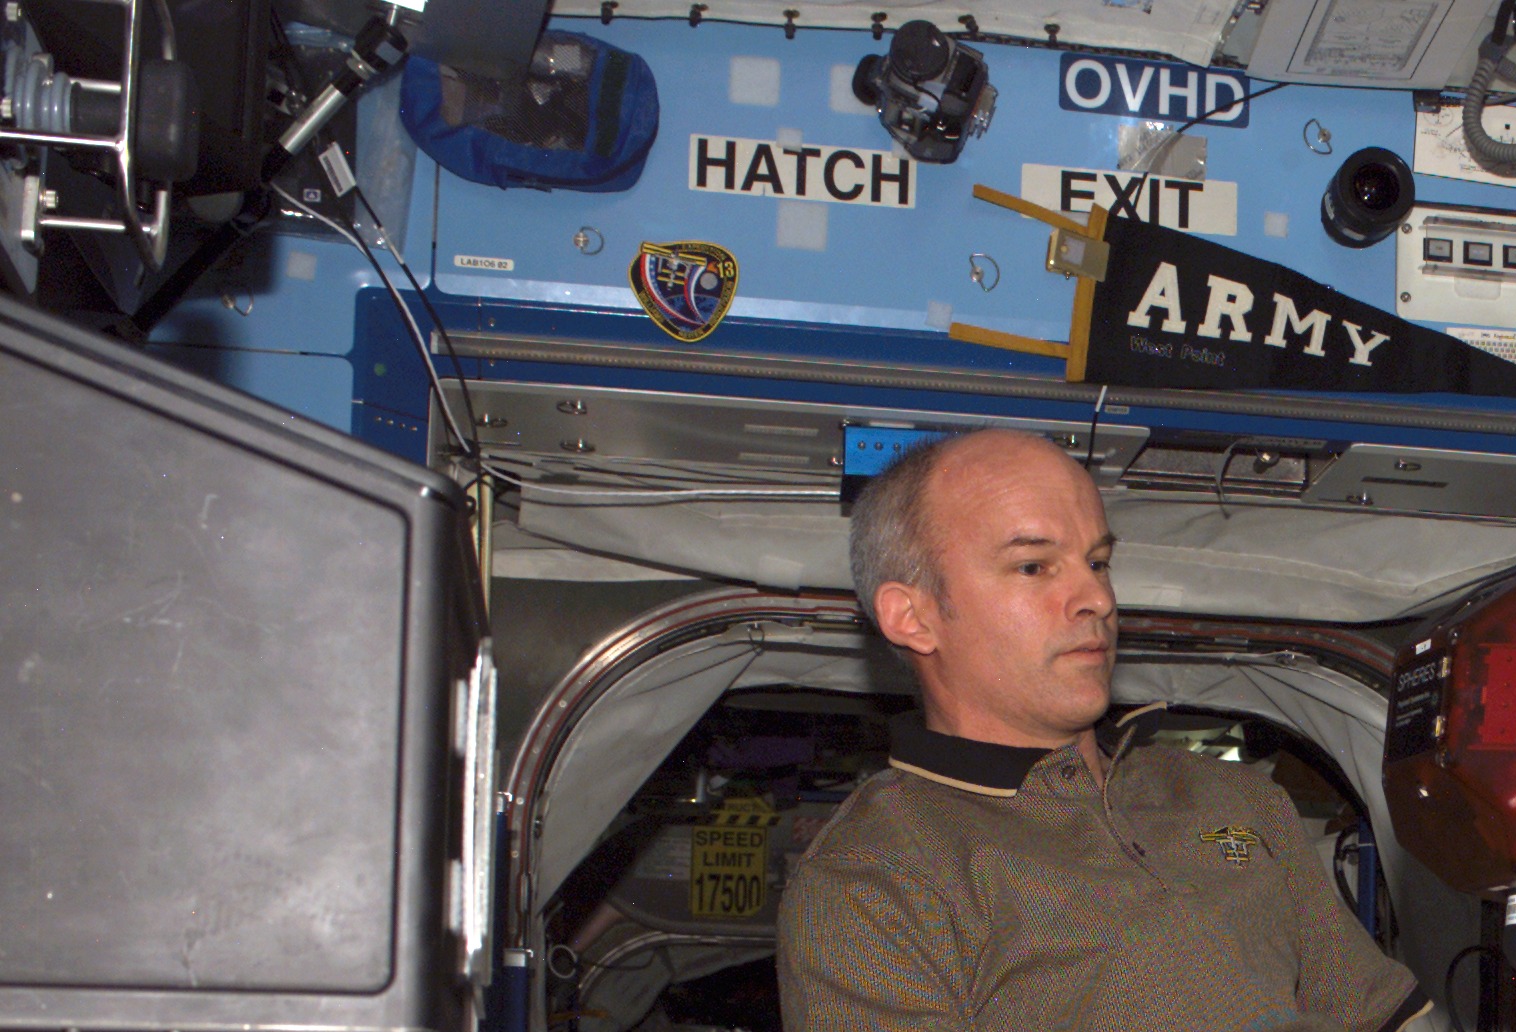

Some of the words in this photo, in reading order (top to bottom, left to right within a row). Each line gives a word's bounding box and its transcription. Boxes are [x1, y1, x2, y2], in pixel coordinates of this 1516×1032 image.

[1065, 59, 1245, 122] OVHD
[697, 138, 909, 205] HATCH
[1061, 170, 1204, 228] EXIT
[717, 262, 734, 278] 13
[1127, 261, 1390, 366] ARMY
[1130, 335, 1173, 359] West
[1180, 343, 1225, 367] Point
[1398, 662, 1436, 692] SPHERES
[695, 830, 763, 848] SPEED
[703, 852, 755, 868] LIMIT
[695, 873, 761, 914] 17500
